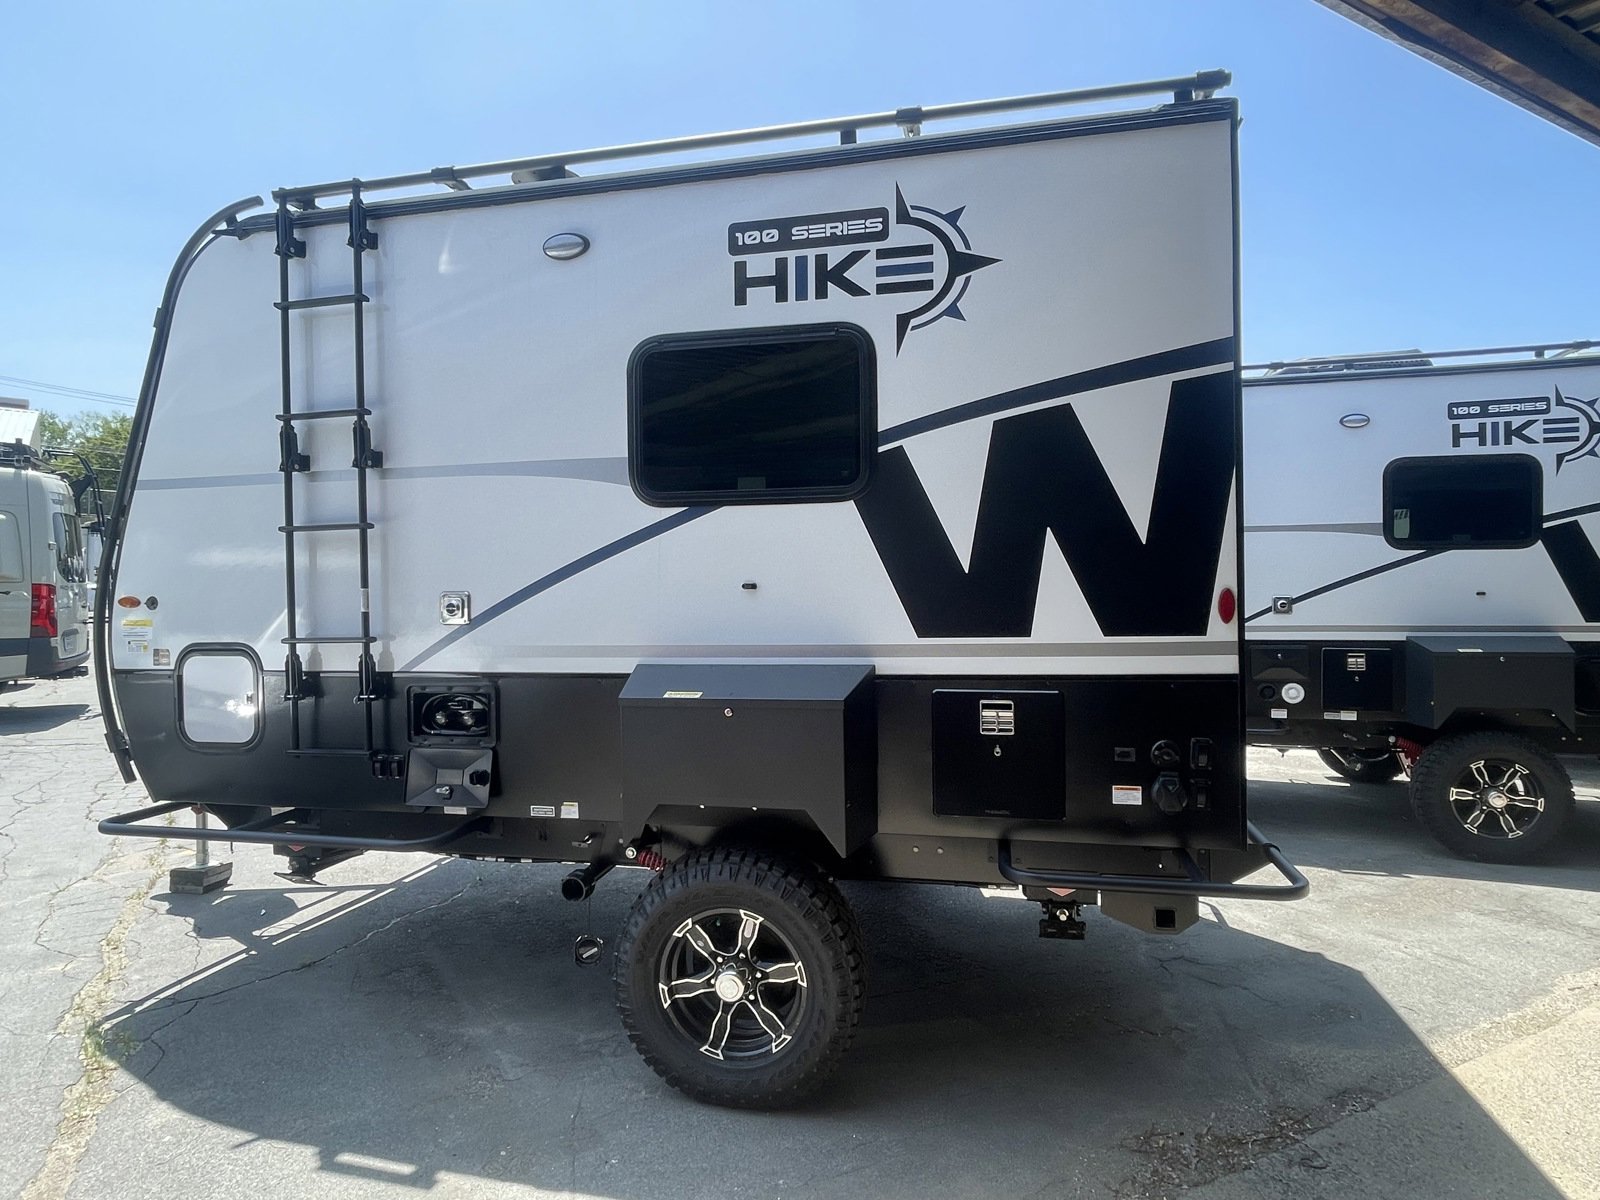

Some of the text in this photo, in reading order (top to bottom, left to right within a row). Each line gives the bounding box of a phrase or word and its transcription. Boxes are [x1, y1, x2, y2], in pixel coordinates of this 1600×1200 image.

[735, 217, 883, 246] 100 SERIES
[733, 243, 934, 306] HIKE
[1451, 401, 1548, 415] 100 SERIES
[1451, 416, 1580, 448] HIKE
